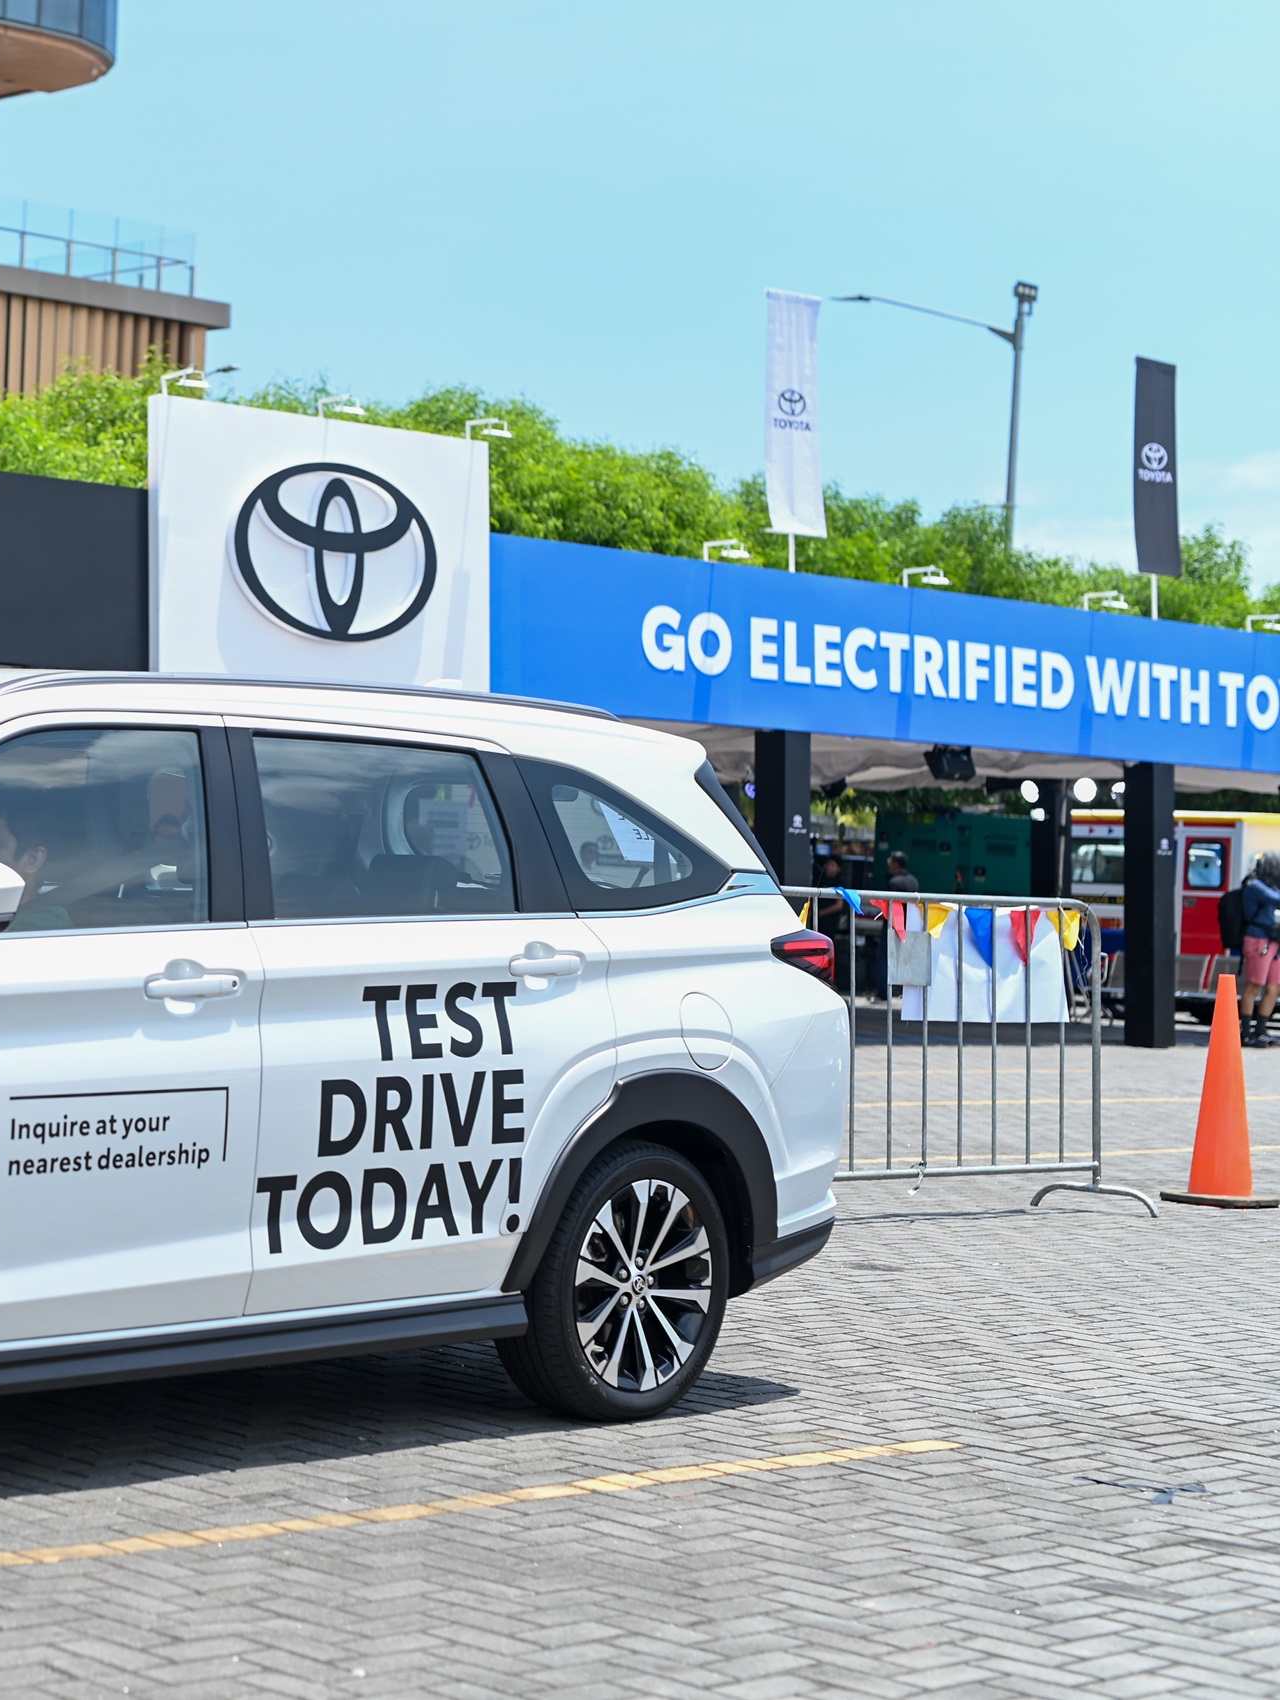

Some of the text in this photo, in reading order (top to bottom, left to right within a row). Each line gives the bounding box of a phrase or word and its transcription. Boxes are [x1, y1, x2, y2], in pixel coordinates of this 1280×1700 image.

[773, 418, 811, 431] TOYOTA
[1137, 468, 1173, 484] TOYOTA
[641, 604, 1280, 733] GO ELECTRIFIED WITH TO
[362, 981, 517, 1061] TEST
[9, 1113, 171, 1144] Inquire at your
[317, 1069, 525, 1157] DRIVE
[7, 1142, 211, 1177] nearest dealership
[256, 1158, 522, 1254] TODAY!
